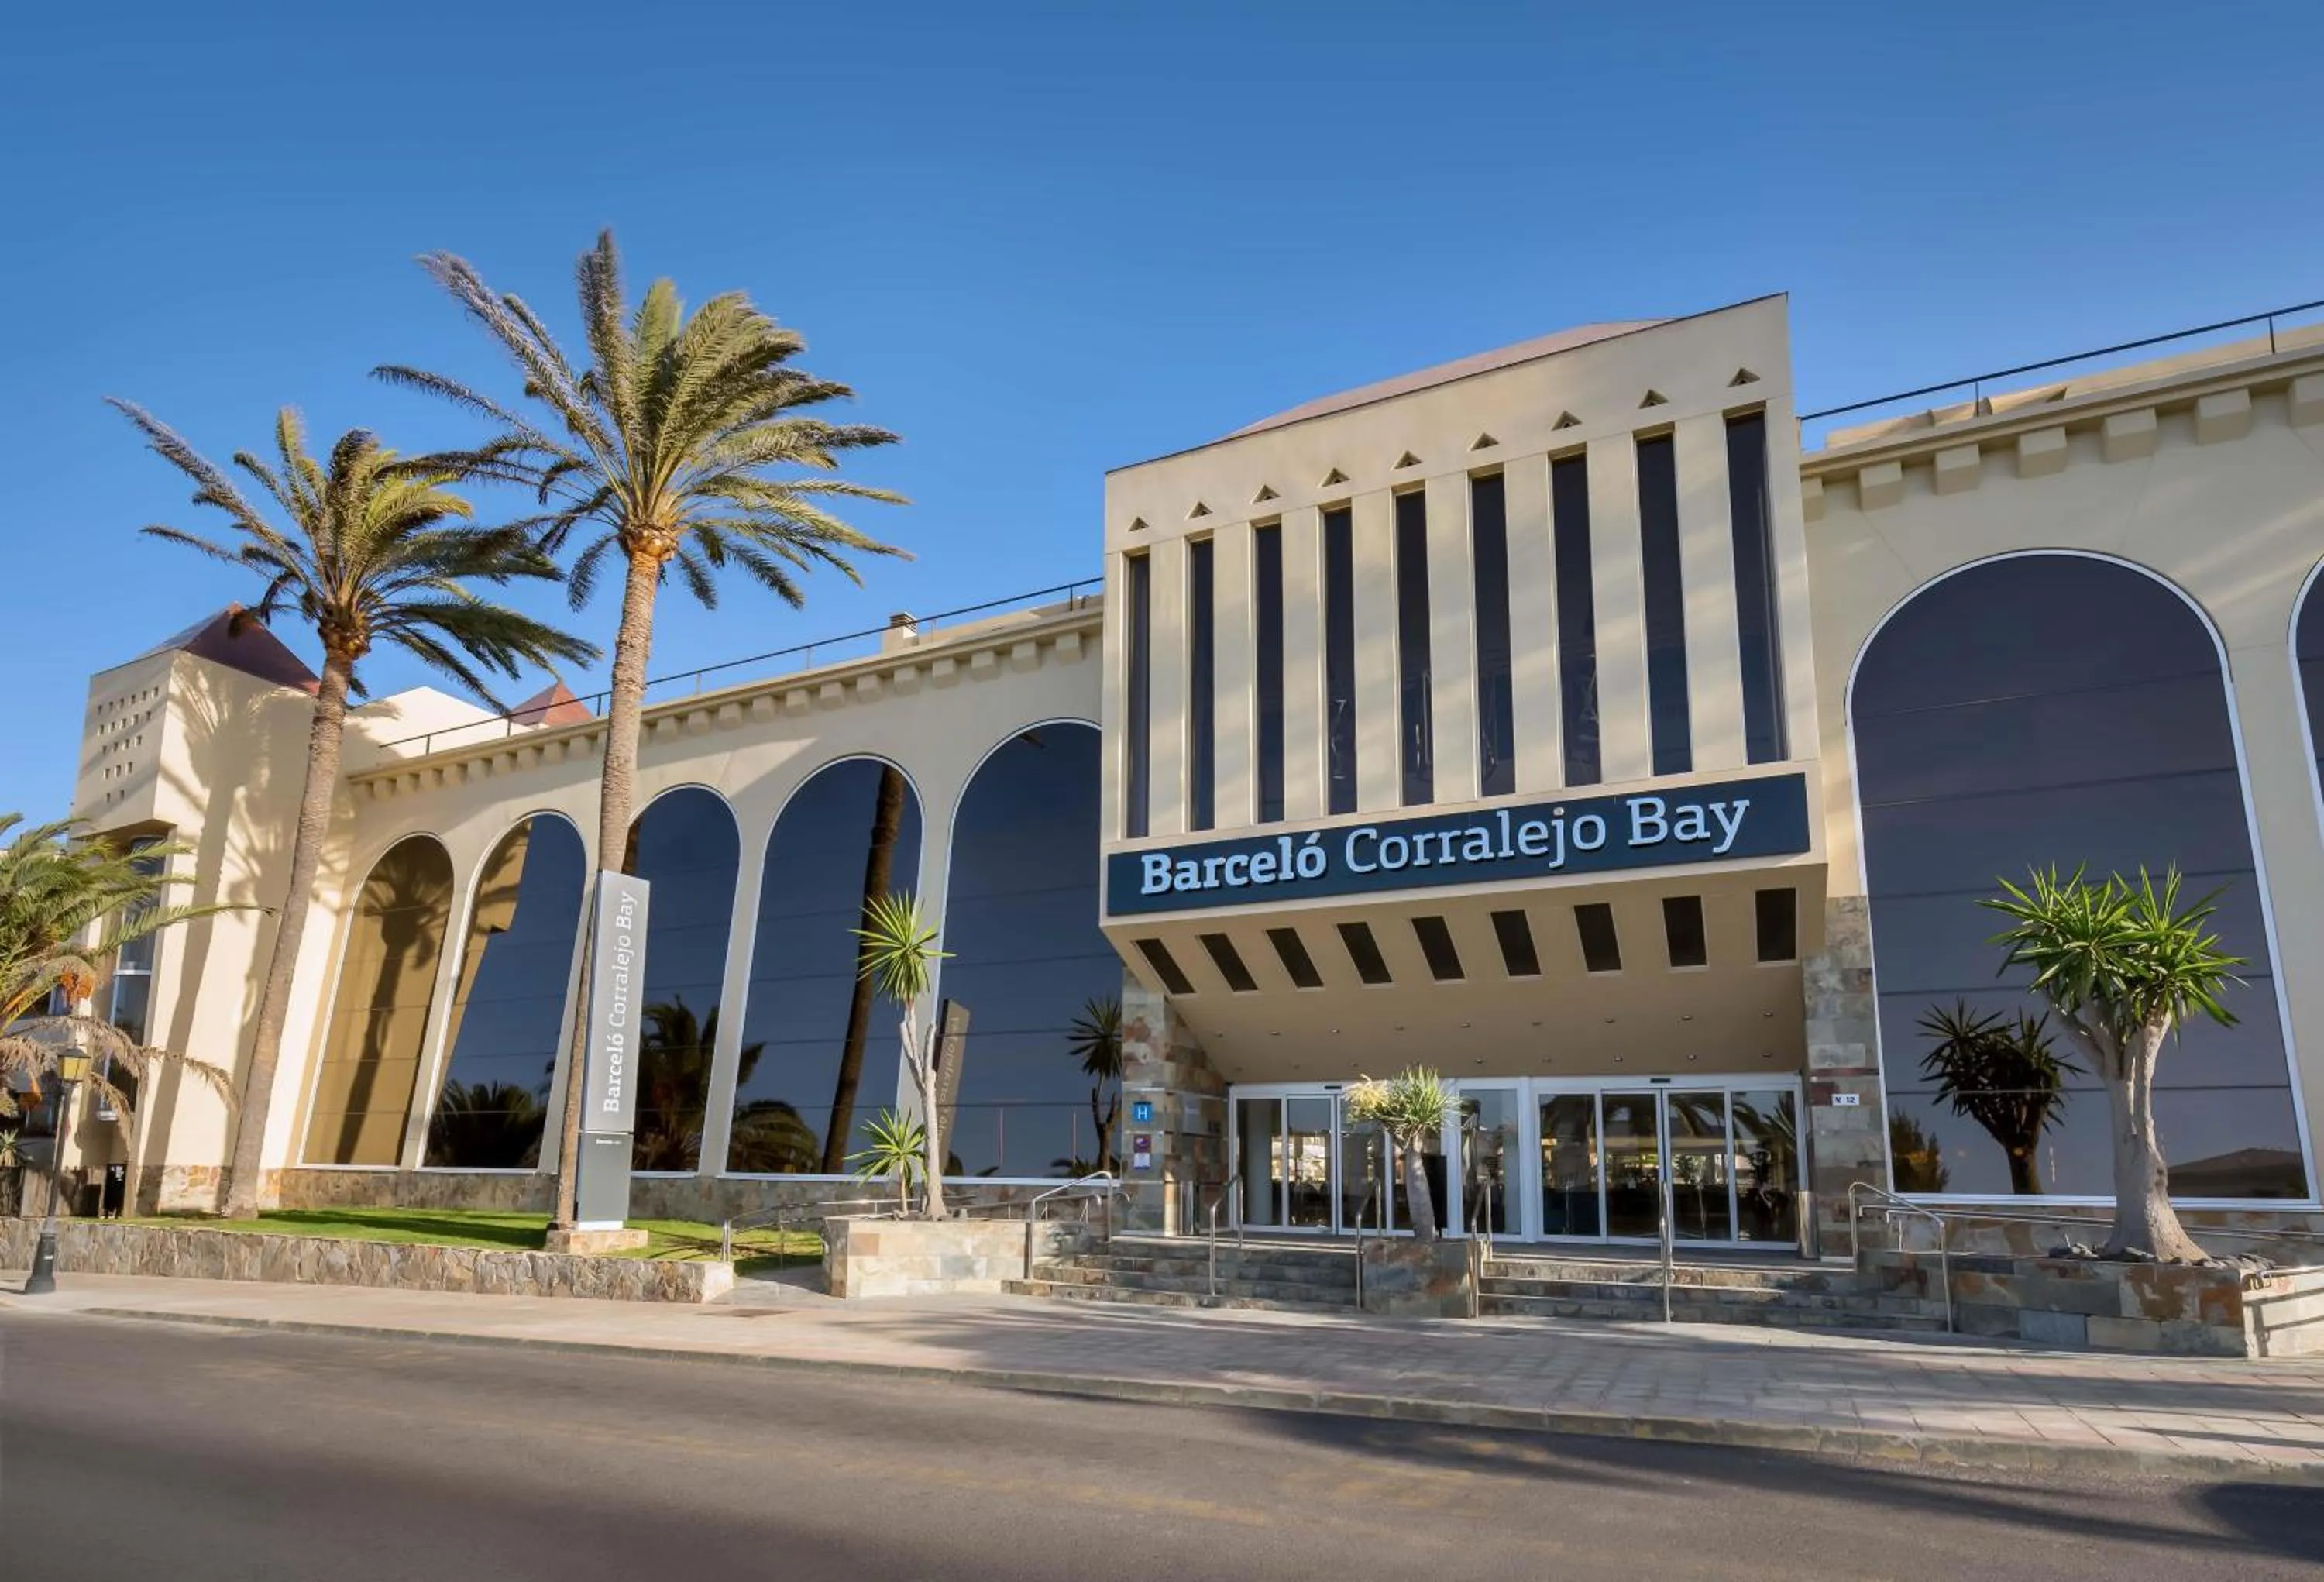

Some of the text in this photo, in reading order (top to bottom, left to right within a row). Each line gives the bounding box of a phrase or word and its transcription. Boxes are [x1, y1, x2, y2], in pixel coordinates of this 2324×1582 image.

[1141, 797, 1750, 895] Barceló Corralejo Bay
[616, 891, 637, 930] Bay
[609, 935, 634, 1027] Corralejo
[603, 1033, 624, 1113] Barceló
[1137, 1106, 1147, 1120] H
